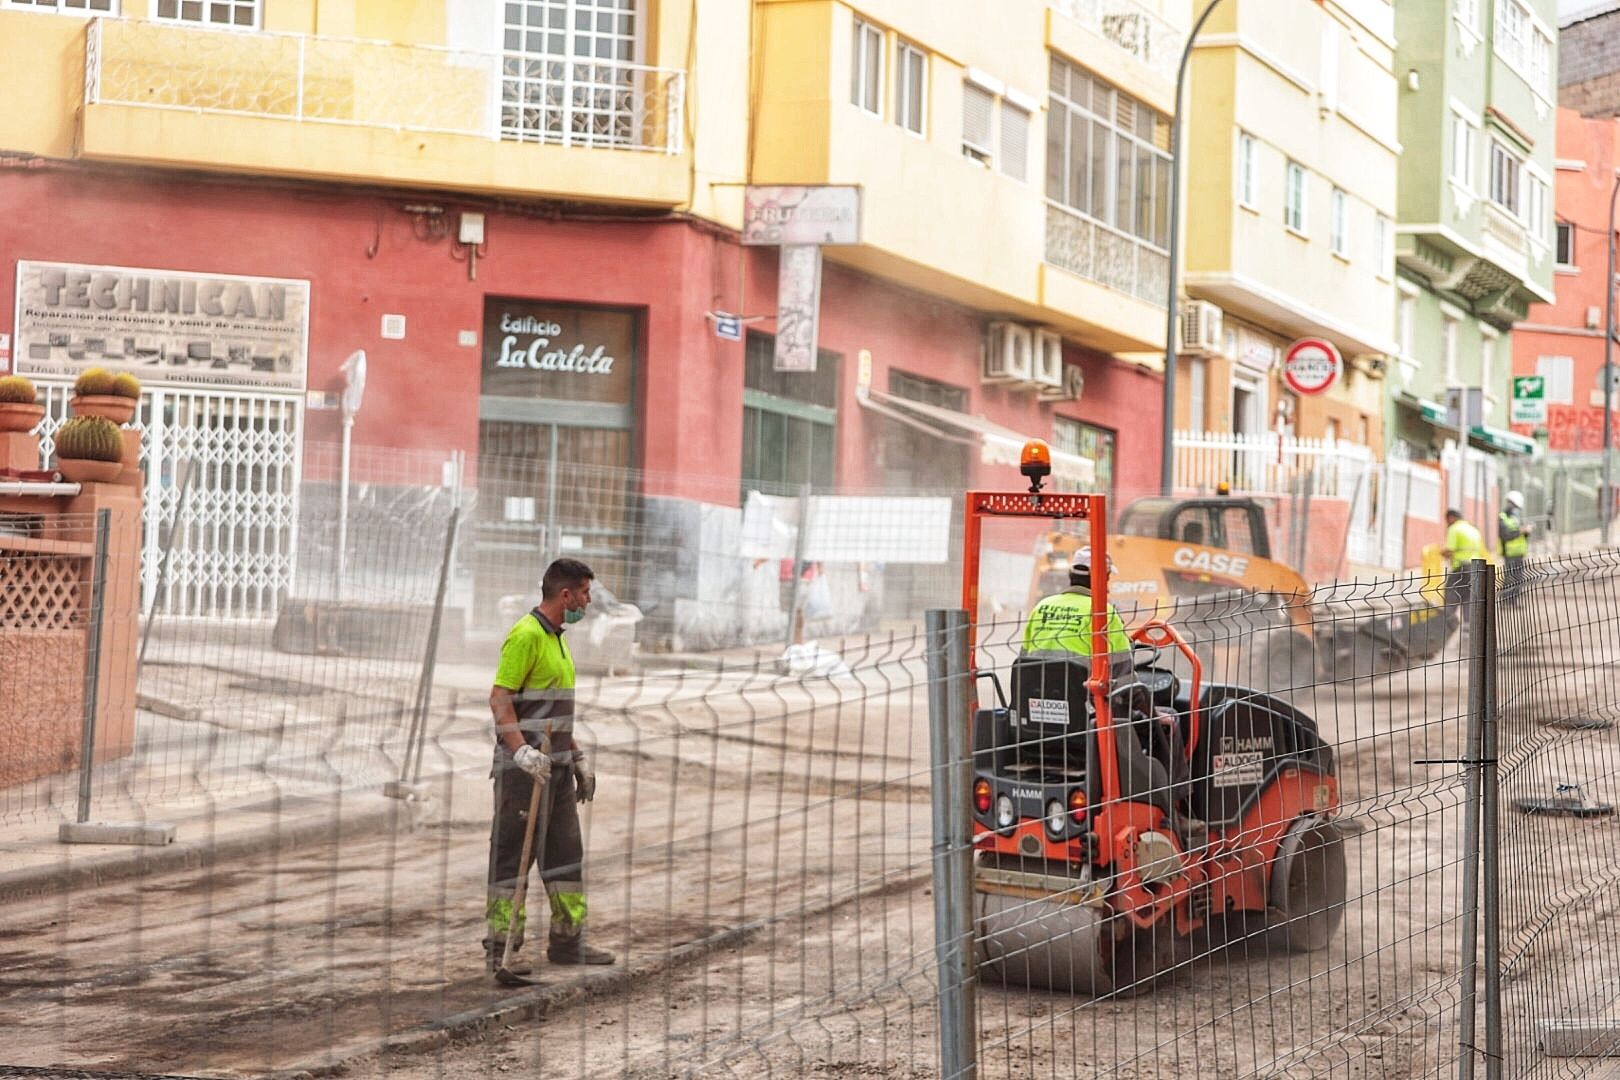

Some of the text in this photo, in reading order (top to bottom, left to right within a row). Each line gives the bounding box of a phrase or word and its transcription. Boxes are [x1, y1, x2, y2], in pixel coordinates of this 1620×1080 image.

[40, 268, 286, 321] TECHNICAN
[180, 320, 211, 328] venta
[215, 321, 228, 329] de
[500, 313, 562, 336] Edificio
[497, 336, 615, 374] La Carlota
[1173, 547, 1249, 577] CASE
[1237, 736, 1273, 750] HAMM
[1012, 788, 1043, 799] HAMM
